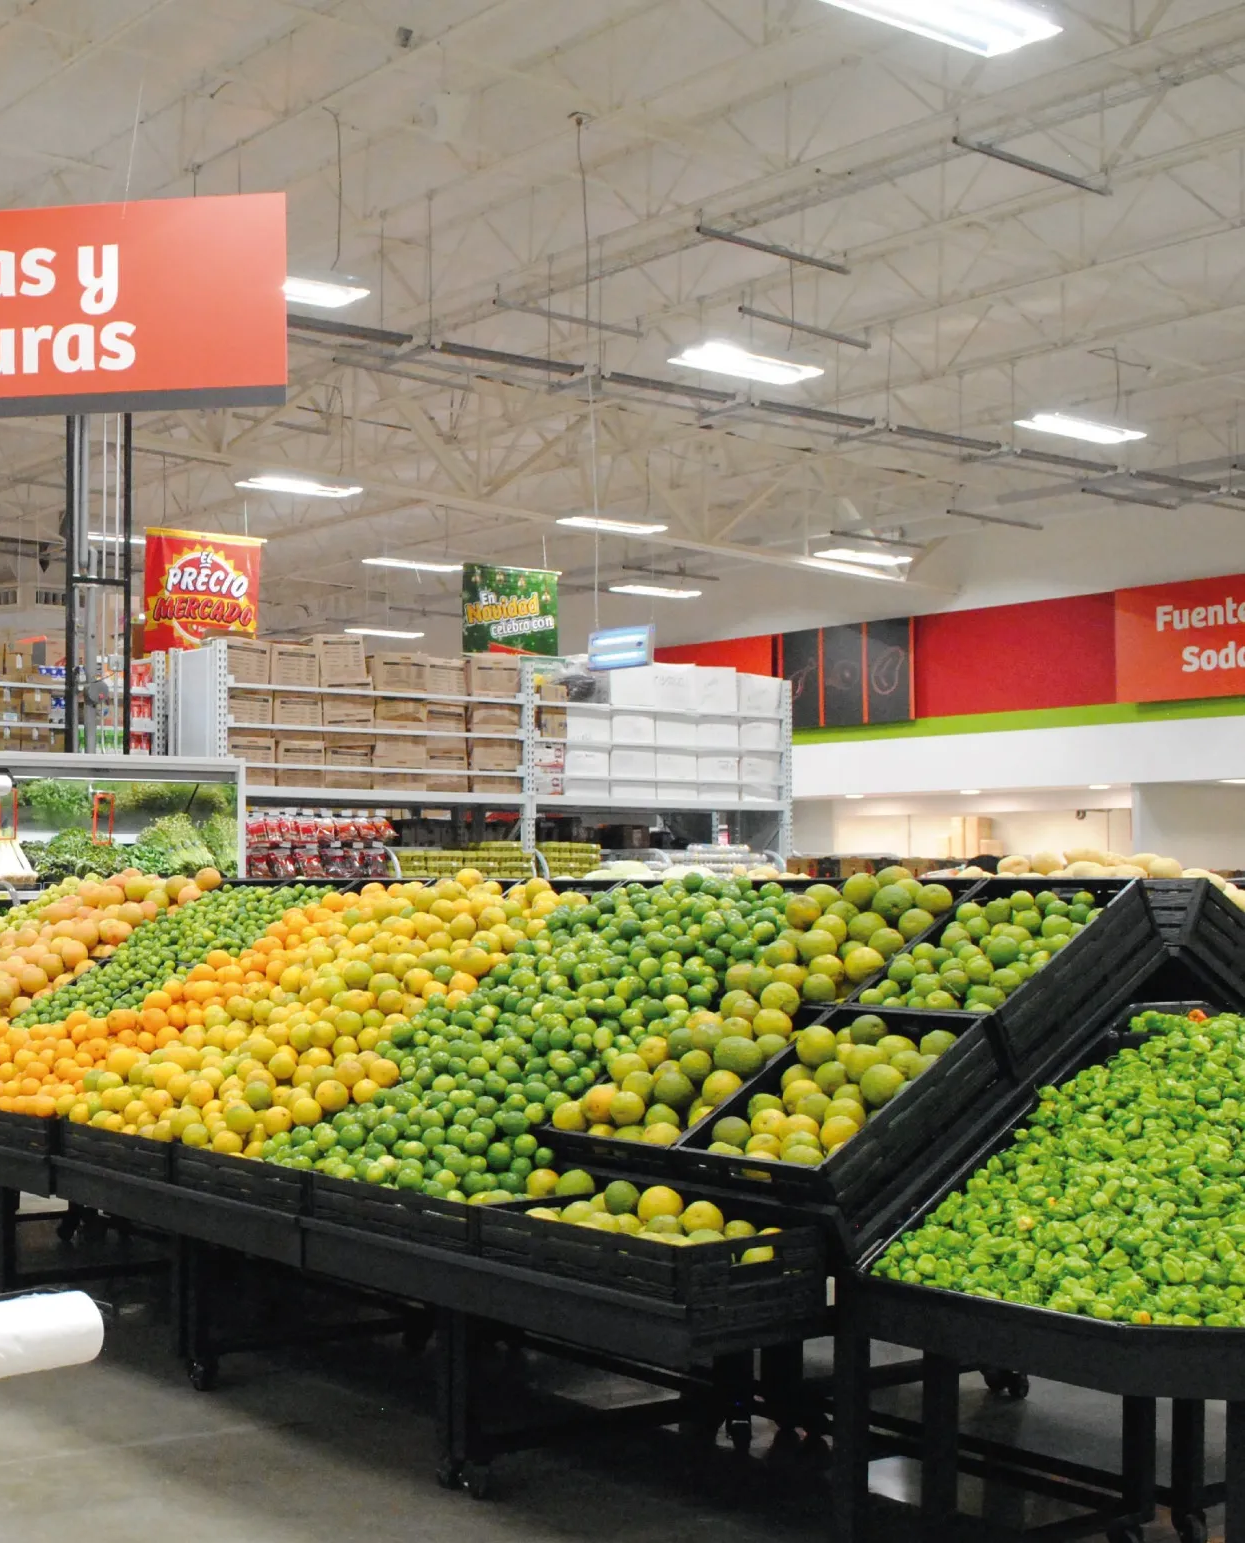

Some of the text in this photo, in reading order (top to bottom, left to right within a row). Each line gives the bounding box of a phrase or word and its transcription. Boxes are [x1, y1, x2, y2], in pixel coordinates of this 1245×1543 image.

[77, 244, 119, 315] y
[200, 551, 213, 564] EL
[166, 567, 249, 598] PRECIO
[153, 596, 253, 626] MERCADO
[466, 592, 539, 624] Navidad
[480, 591, 496, 605] En
[532, 616, 554, 630] con
